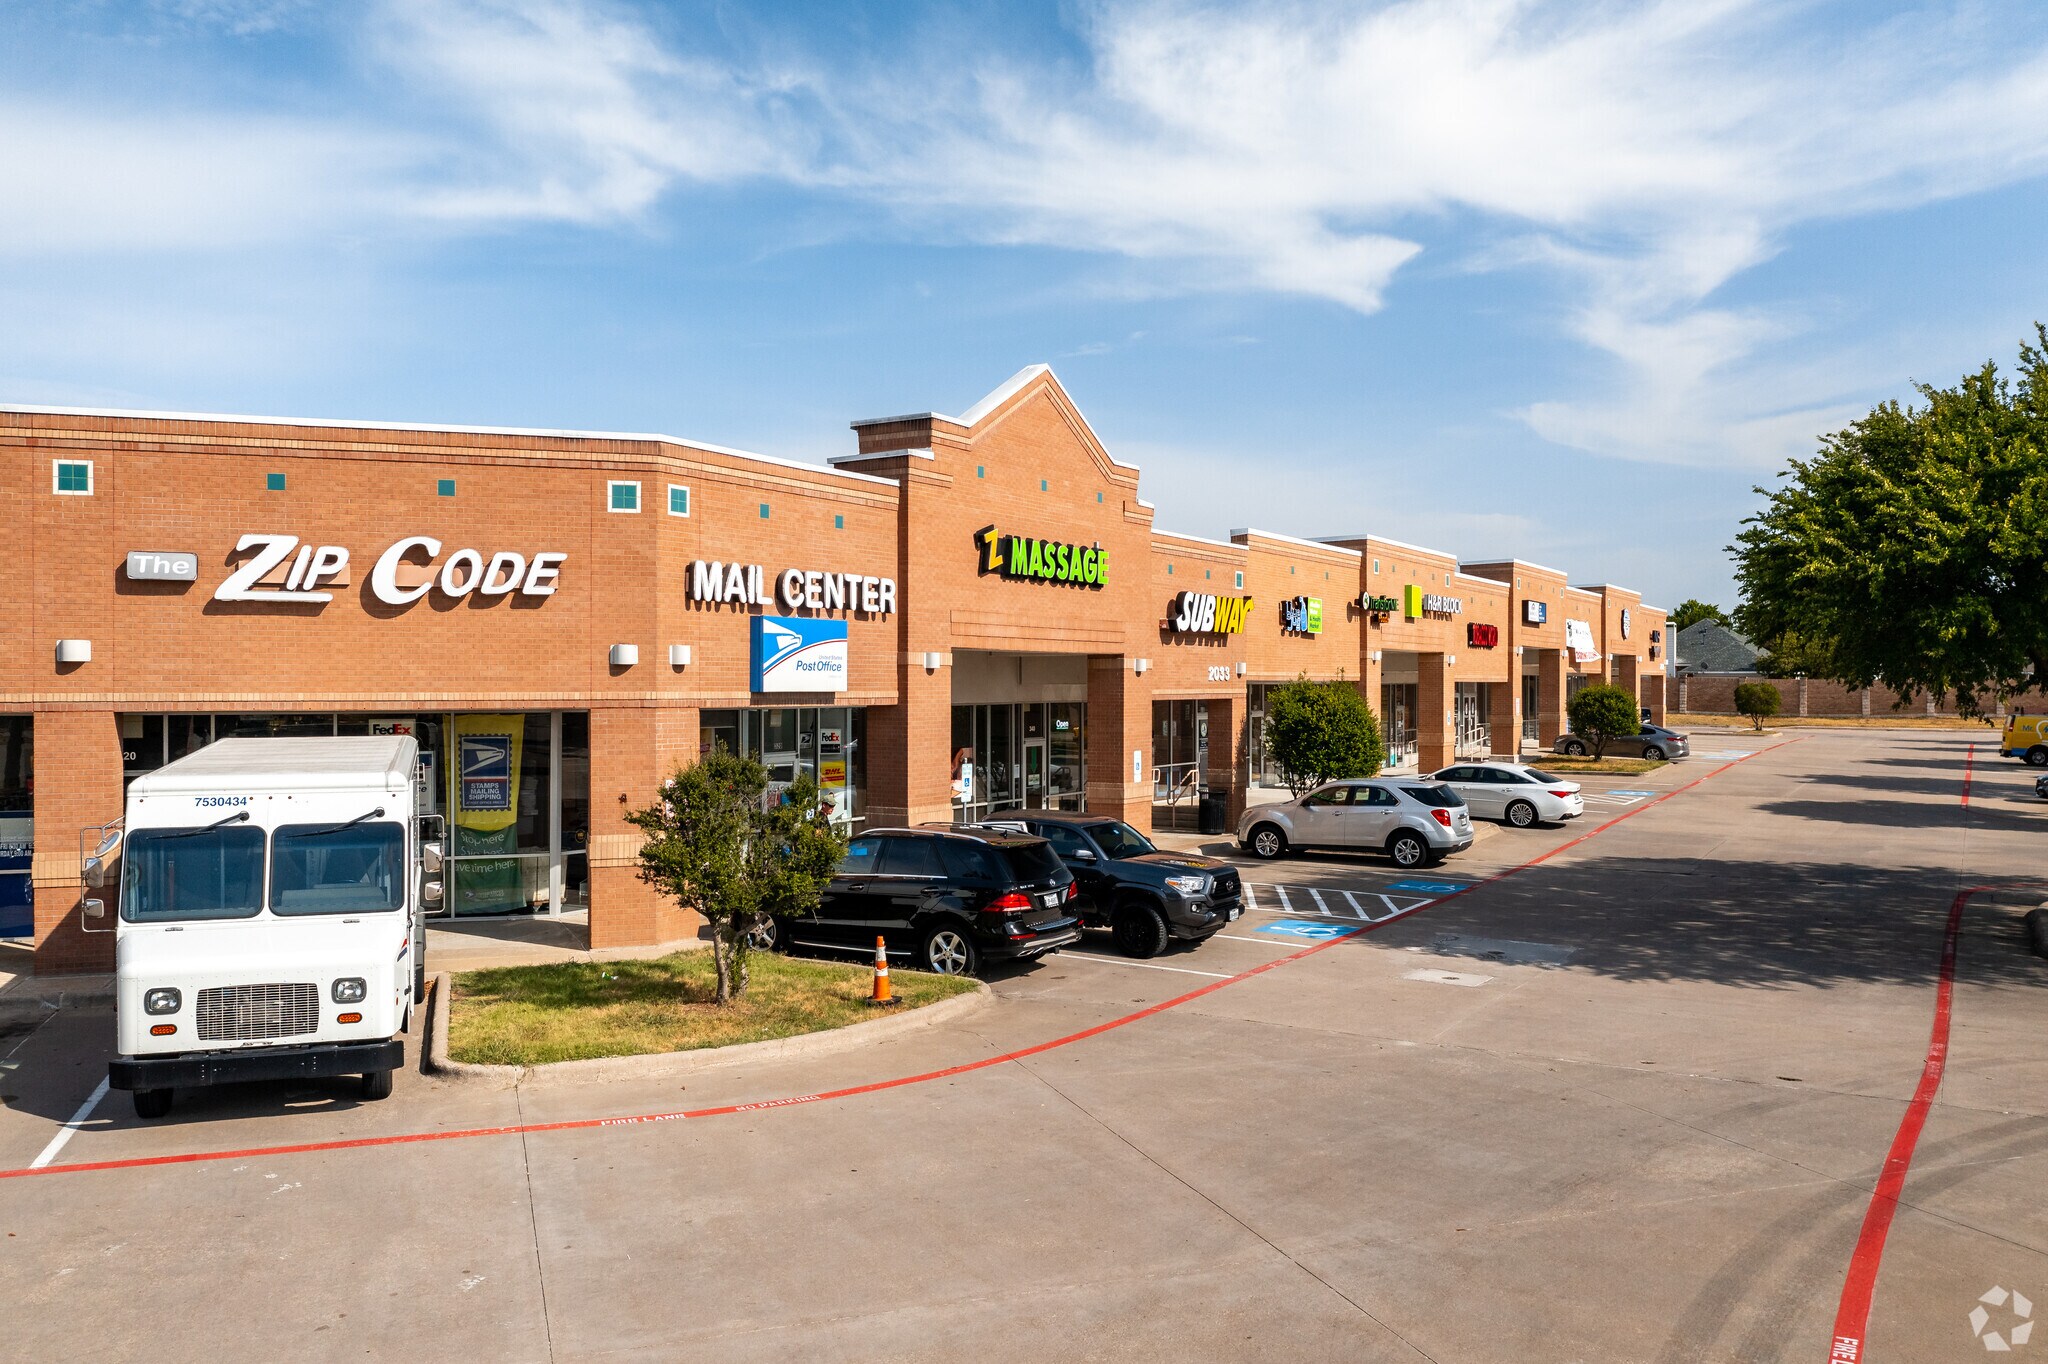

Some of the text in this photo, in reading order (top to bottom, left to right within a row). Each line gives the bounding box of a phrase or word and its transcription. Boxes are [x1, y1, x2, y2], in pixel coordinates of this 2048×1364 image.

[984, 528, 1109, 585] Z MASSAGE
[133, 555, 190, 575] The
[372, 536, 568, 604] CODE
[693, 560, 896, 613] MAIL CENTER
[1428, 594, 1462, 614] H&R BLOCK
[1177, 591, 1254, 634] SUBWAY
[796, 660, 842, 671] Post Office
[1208, 666, 1230, 681] 2033
[373, 724, 411, 735] FedEx
[1056, 720, 1069, 728] Open
[822, 733, 840, 741] FedEx
[195, 797, 247, 806] 7530434
[460, 833, 480, 846] Stop
[455, 863, 471, 872] ave
[736, 1095, 821, 1112] NO PARKING
[601, 1113, 686, 1126] FIRE LANE
[1832, 1336, 1859, 1360] FIRE
